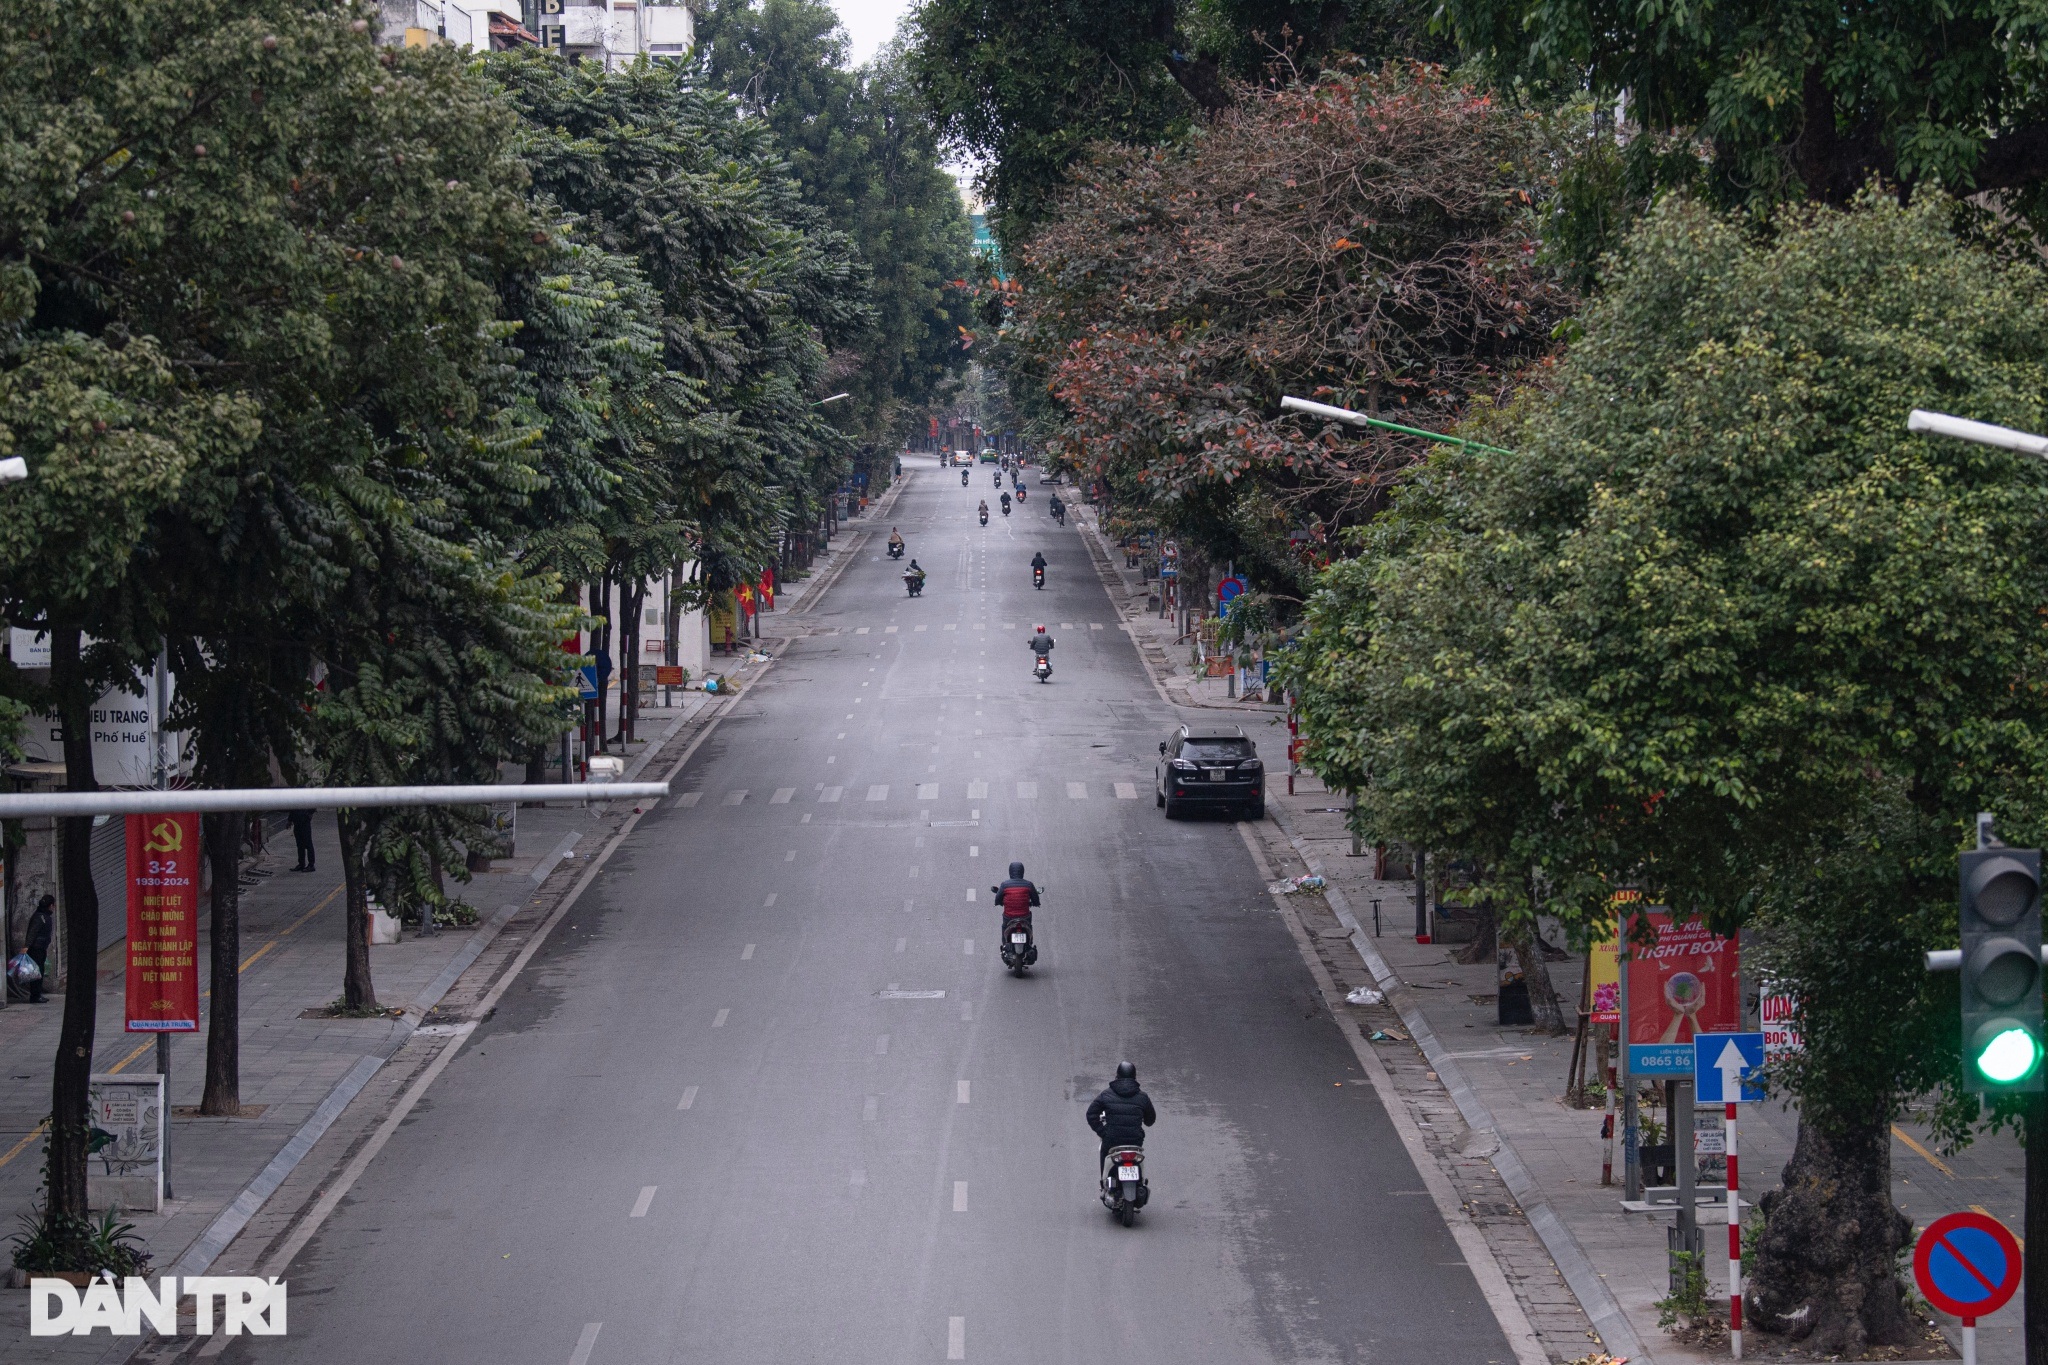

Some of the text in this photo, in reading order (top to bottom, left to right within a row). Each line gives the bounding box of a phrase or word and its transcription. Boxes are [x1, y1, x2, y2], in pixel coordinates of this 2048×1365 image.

[90, 710, 106, 723] IEU
[110, 710, 148, 723] TRANG
[95, 731, 146, 742] Phố Huế
[149, 861, 177, 874] 3-2
[144, 894, 181, 907] NHIỆT LIỆT
[141, 909, 160, 920] CHÀO
[149, 924, 176, 936] 94 NĂM
[132, 940, 193, 953] NGÀY THÀNH LẬP
[1689, 940, 1727, 955] BOX
[132, 953, 192, 968] ĐẢNG CỘNG SẢN
[142, 970, 158, 983] VIỆT
[160, 972, 177, 981] NAM
[1765, 1032, 1787, 1047] BỌC
[1641, 1056, 1690, 1066] 0865 86
